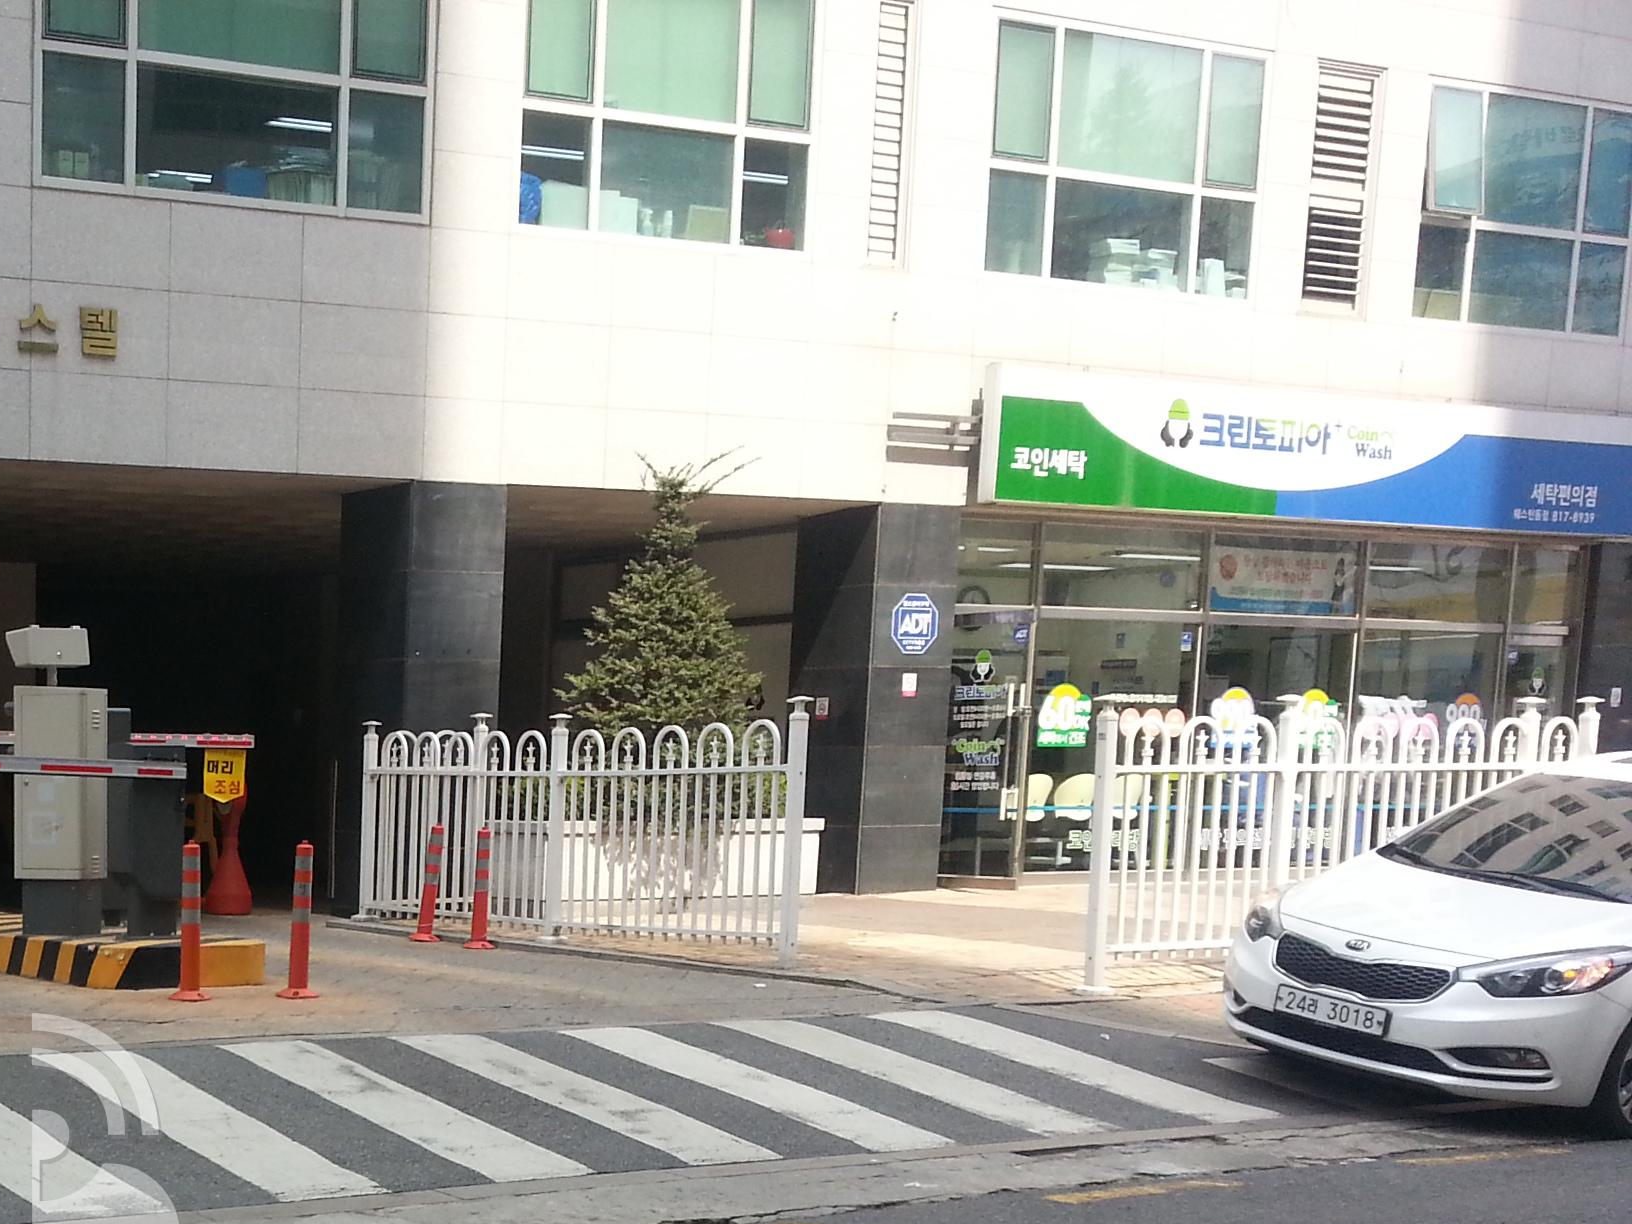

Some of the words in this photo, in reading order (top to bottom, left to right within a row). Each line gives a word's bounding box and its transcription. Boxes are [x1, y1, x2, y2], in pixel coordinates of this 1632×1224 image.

[1199, 412, 1331, 455] 크린토피아
[1347, 425, 1379, 441] Coin
[1355, 442, 1392, 460] Wash
[1010, 446, 1088, 480] 코인세탁
[1530, 483, 1598, 508] 세탁편의점
[900, 612, 932, 635] ADT
[208, 760, 234, 774] 머리
[963, 751, 999, 766] Wash
[214, 780, 241, 794] 조심
[1326, 1001, 1375, 1029] 3018
